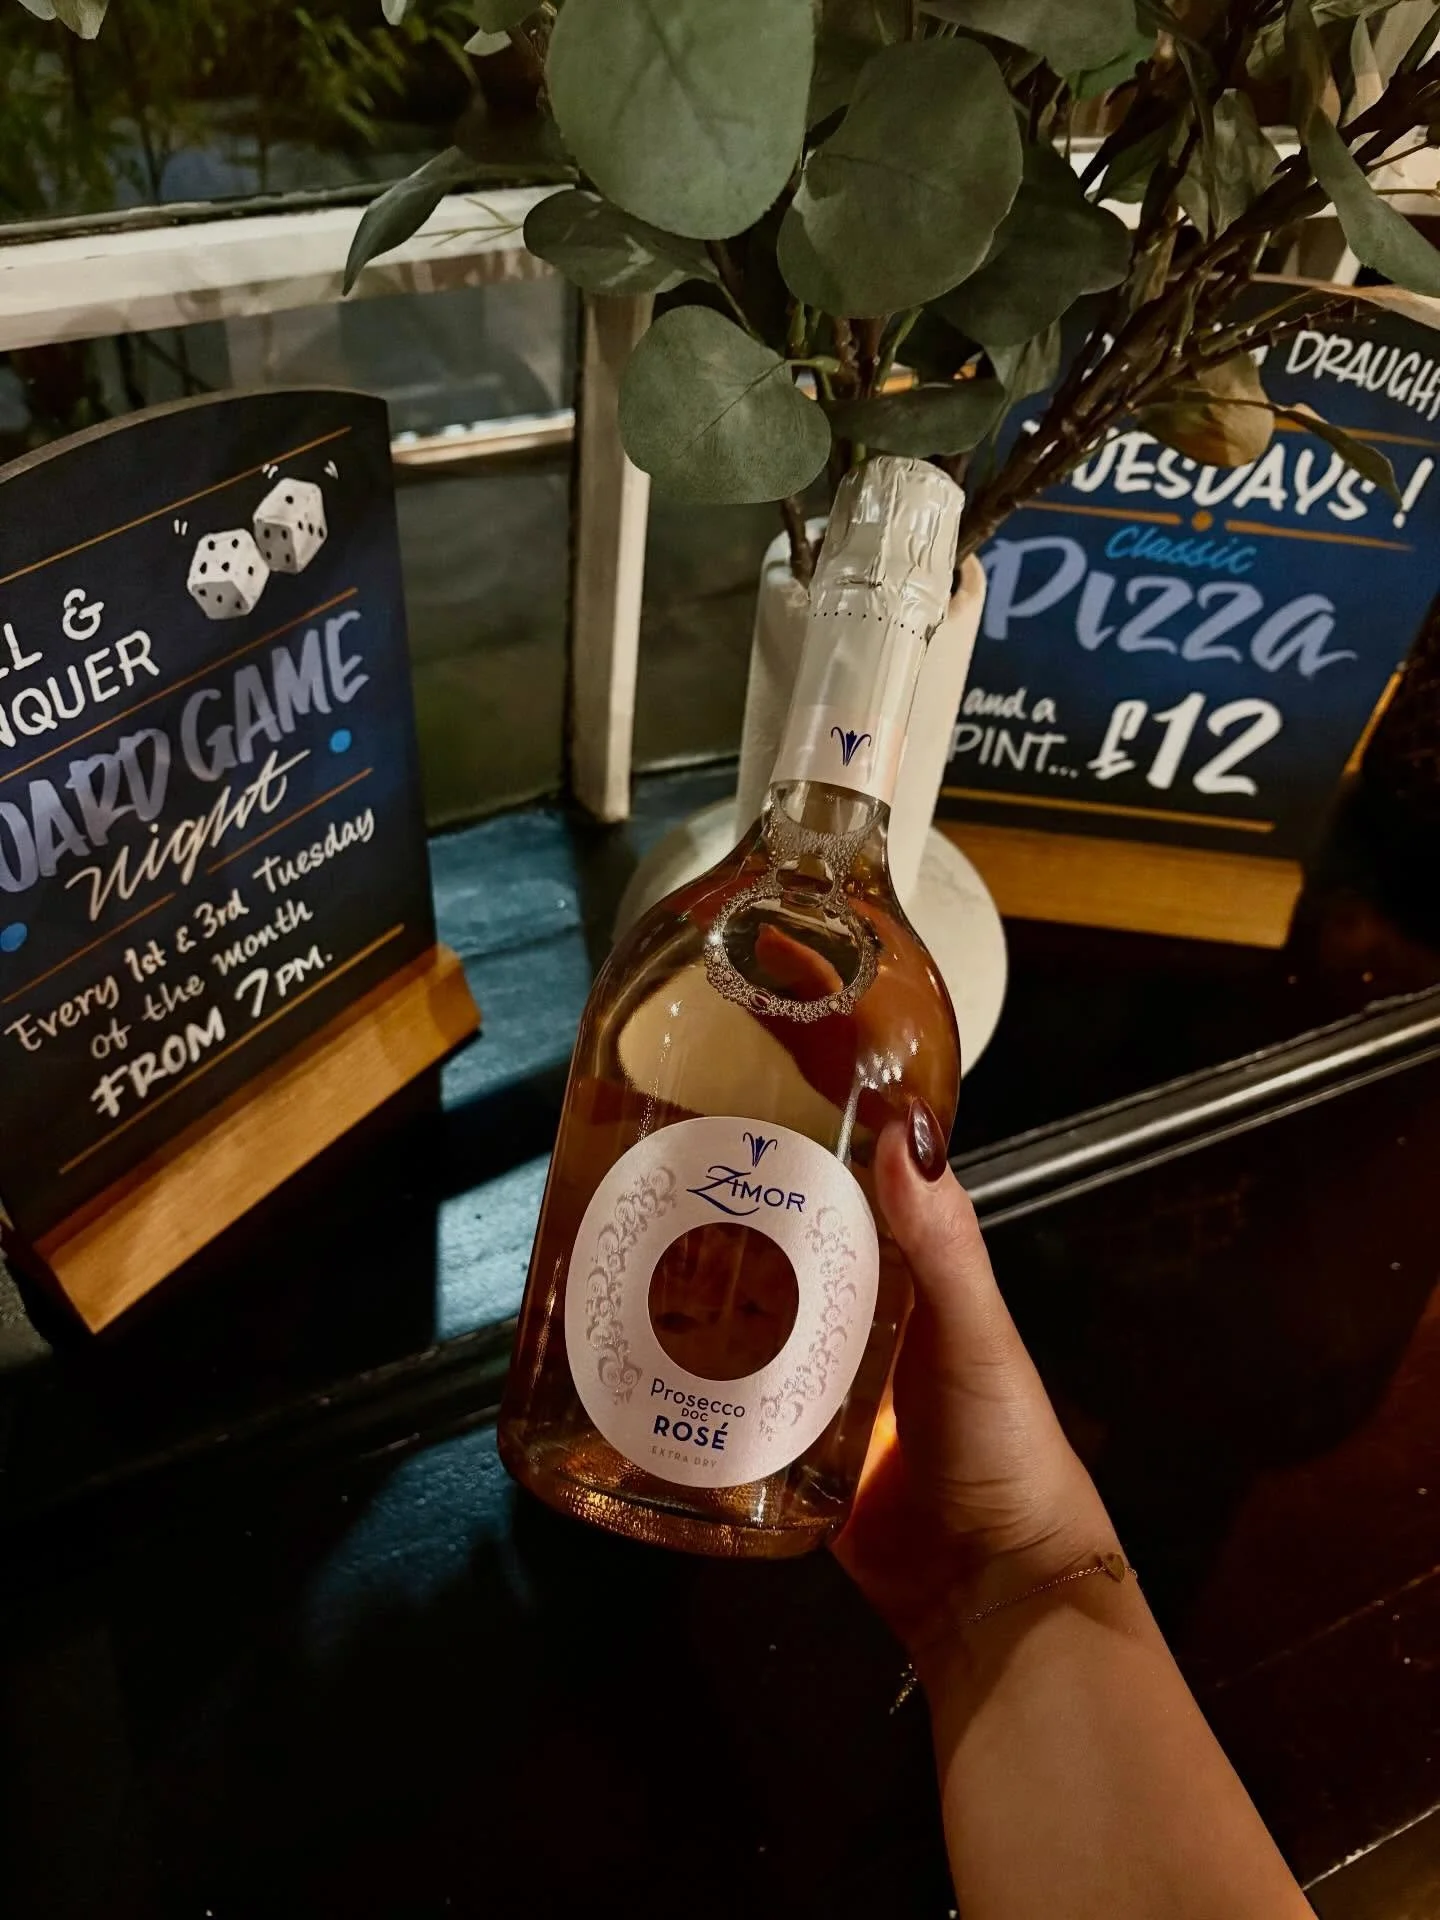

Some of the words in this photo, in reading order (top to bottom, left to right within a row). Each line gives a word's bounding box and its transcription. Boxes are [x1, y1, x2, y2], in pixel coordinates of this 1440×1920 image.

[1286, 329, 1440, 422] DRAUGH
[1104, 524, 1257, 574] Classic
[0, 622, 43, 680] L
[62, 588, 105, 641] &
[180, 611, 370, 782] GAME
[962, 686, 1026, 721] and
[1031, 697, 1056, 723] a
[1087, 692, 1282, 796] £12
[64, 749, 311, 921] Night
[4, 975, 119, 1051] Every
[124, 940, 167, 982] 1st
[176, 926, 197, 954] &
[194, 889, 249, 938] 3rd
[90, 1018, 132, 1059] of
[142, 974, 206, 1021] the
[211, 899, 314, 976] month
[90, 1005, 226, 1118] FROM
[235, 967, 269, 1018] 7
[686, 1165, 807, 1217] ZIMOR
[650, 1377, 746, 1418] Prosecco
[653, 1414, 729, 1451] ROSÉ
[681, 1407, 709, 1422] DOC
[651, 1445, 689, 1465] EXTRA
[693, 1456, 718, 1469] DRY
